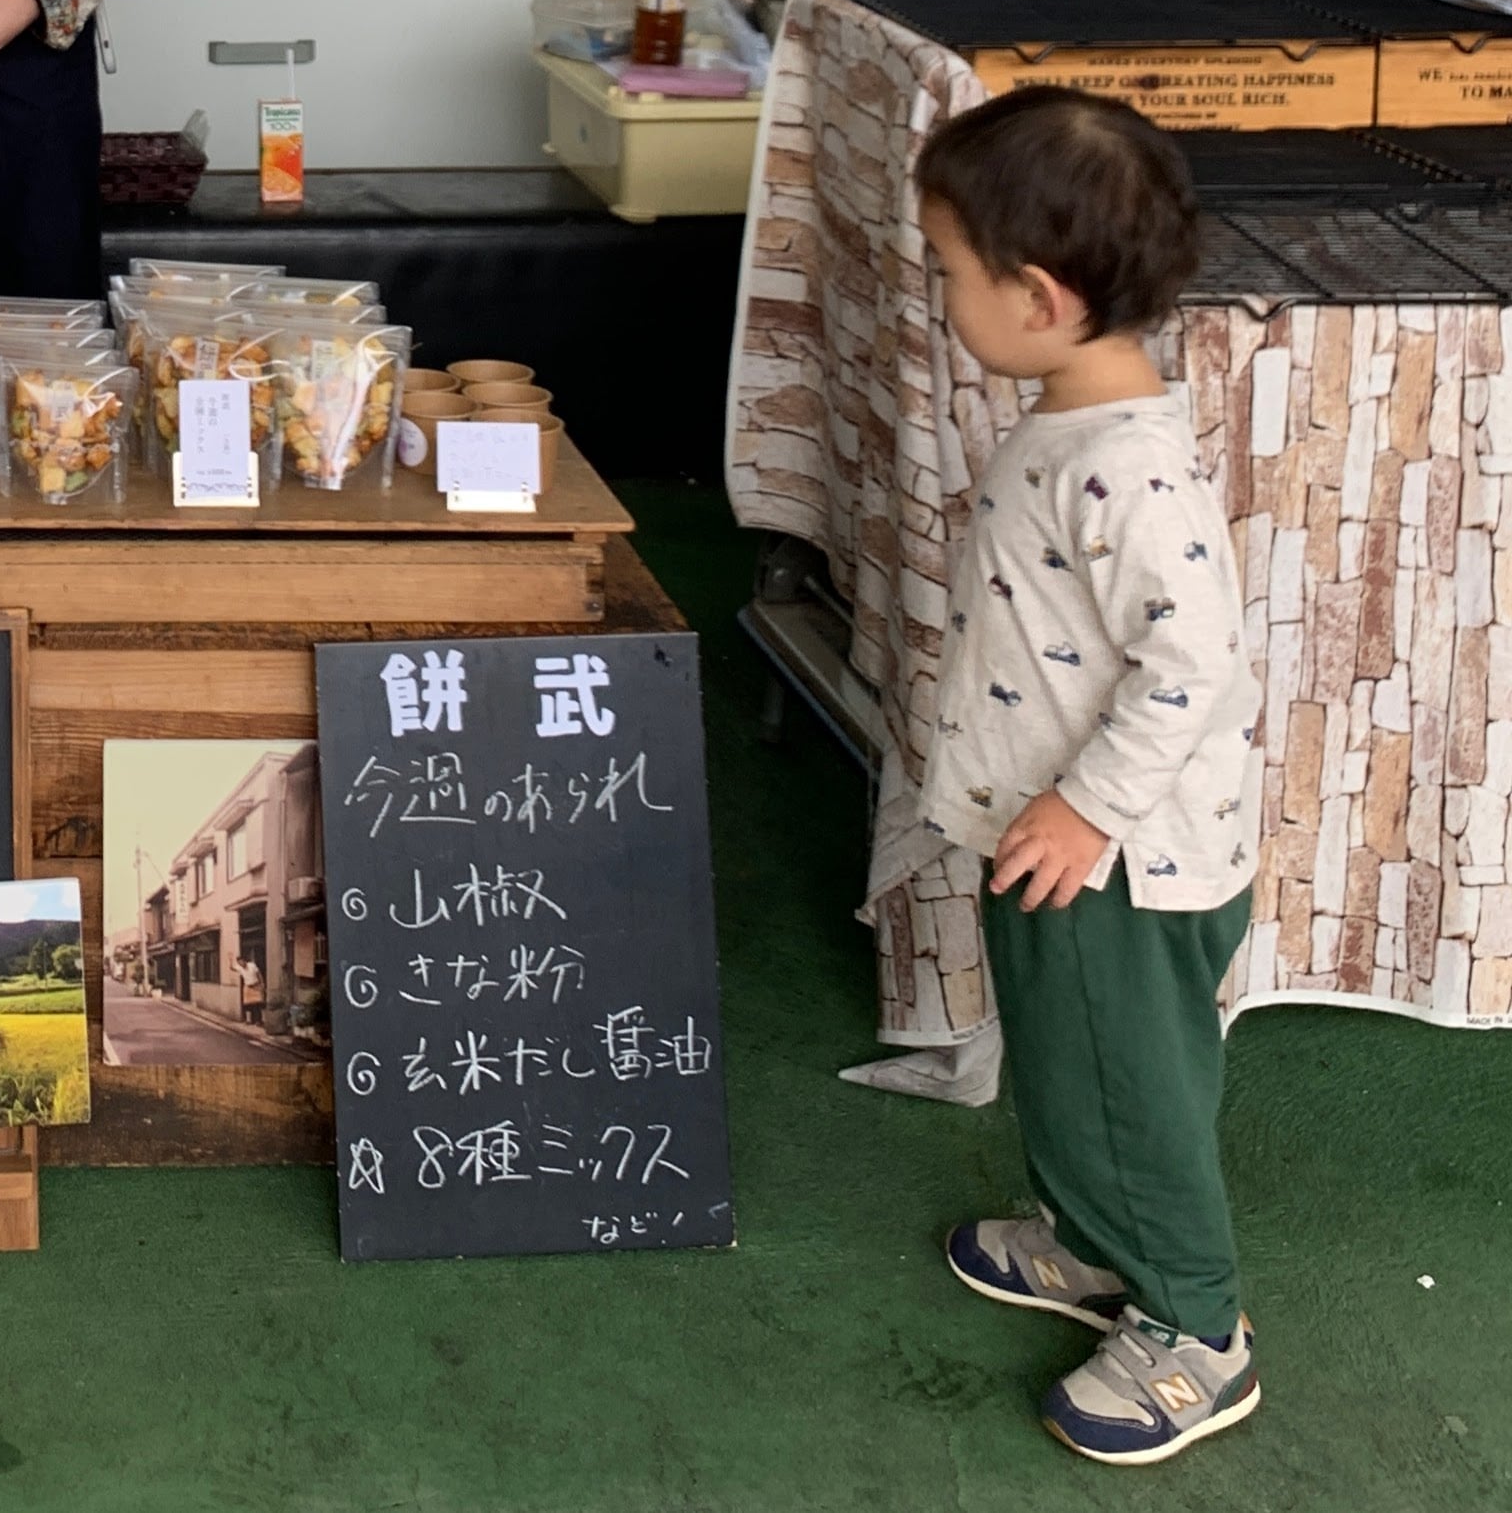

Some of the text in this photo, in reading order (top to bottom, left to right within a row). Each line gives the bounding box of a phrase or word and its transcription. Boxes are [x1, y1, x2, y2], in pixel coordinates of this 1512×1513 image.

[1140, 93, 1186, 107] YOUR
[1192, 92, 1236, 106] SOUL
[1144, 72, 1238, 88] REATING
[1243, 71, 1335, 87] HAPPINESS
[1460, 85, 1485, 100] TO
[379, 648, 615, 737] 餅武
[344, 751, 674, 838] 今週のあられ
[390, 862, 567, 929] 山椒
[398, 944, 585, 1006] きな粉
[401, 1006, 712, 1096] 玄米だし醤油
[412, 1119, 691, 1189] 8種ミックス
[1032, 1254, 1068, 1289] N
[1151, 1372, 1202, 1413] N
